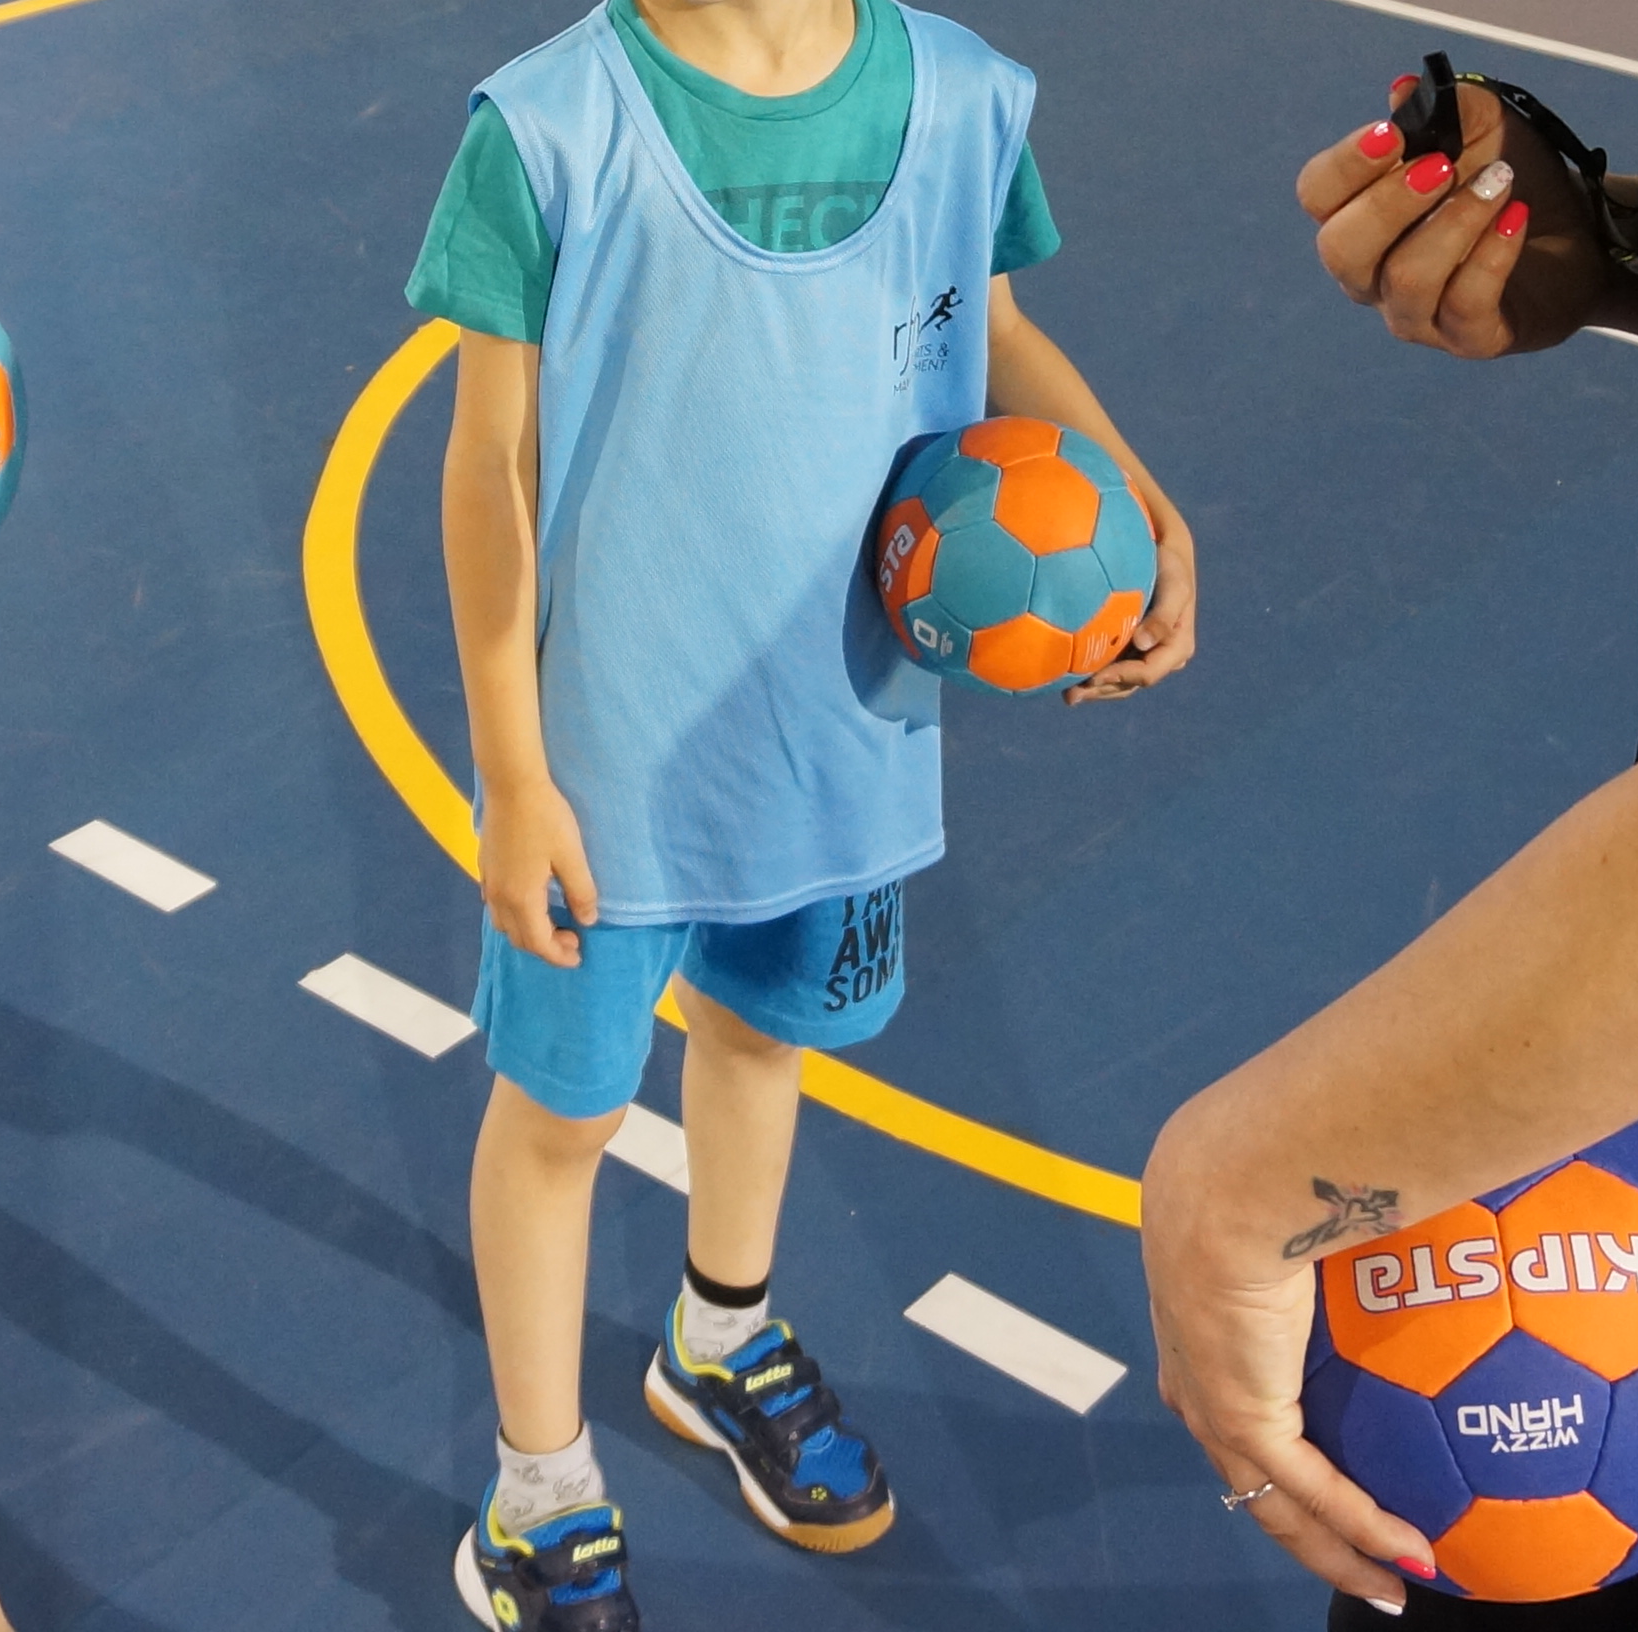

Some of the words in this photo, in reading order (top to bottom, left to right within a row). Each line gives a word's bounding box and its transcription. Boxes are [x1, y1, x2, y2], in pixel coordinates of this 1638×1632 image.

[829, 898, 901, 976] AW
[823, 941, 899, 1013] SOM
[1456, 1394, 1584, 1436] HAND
